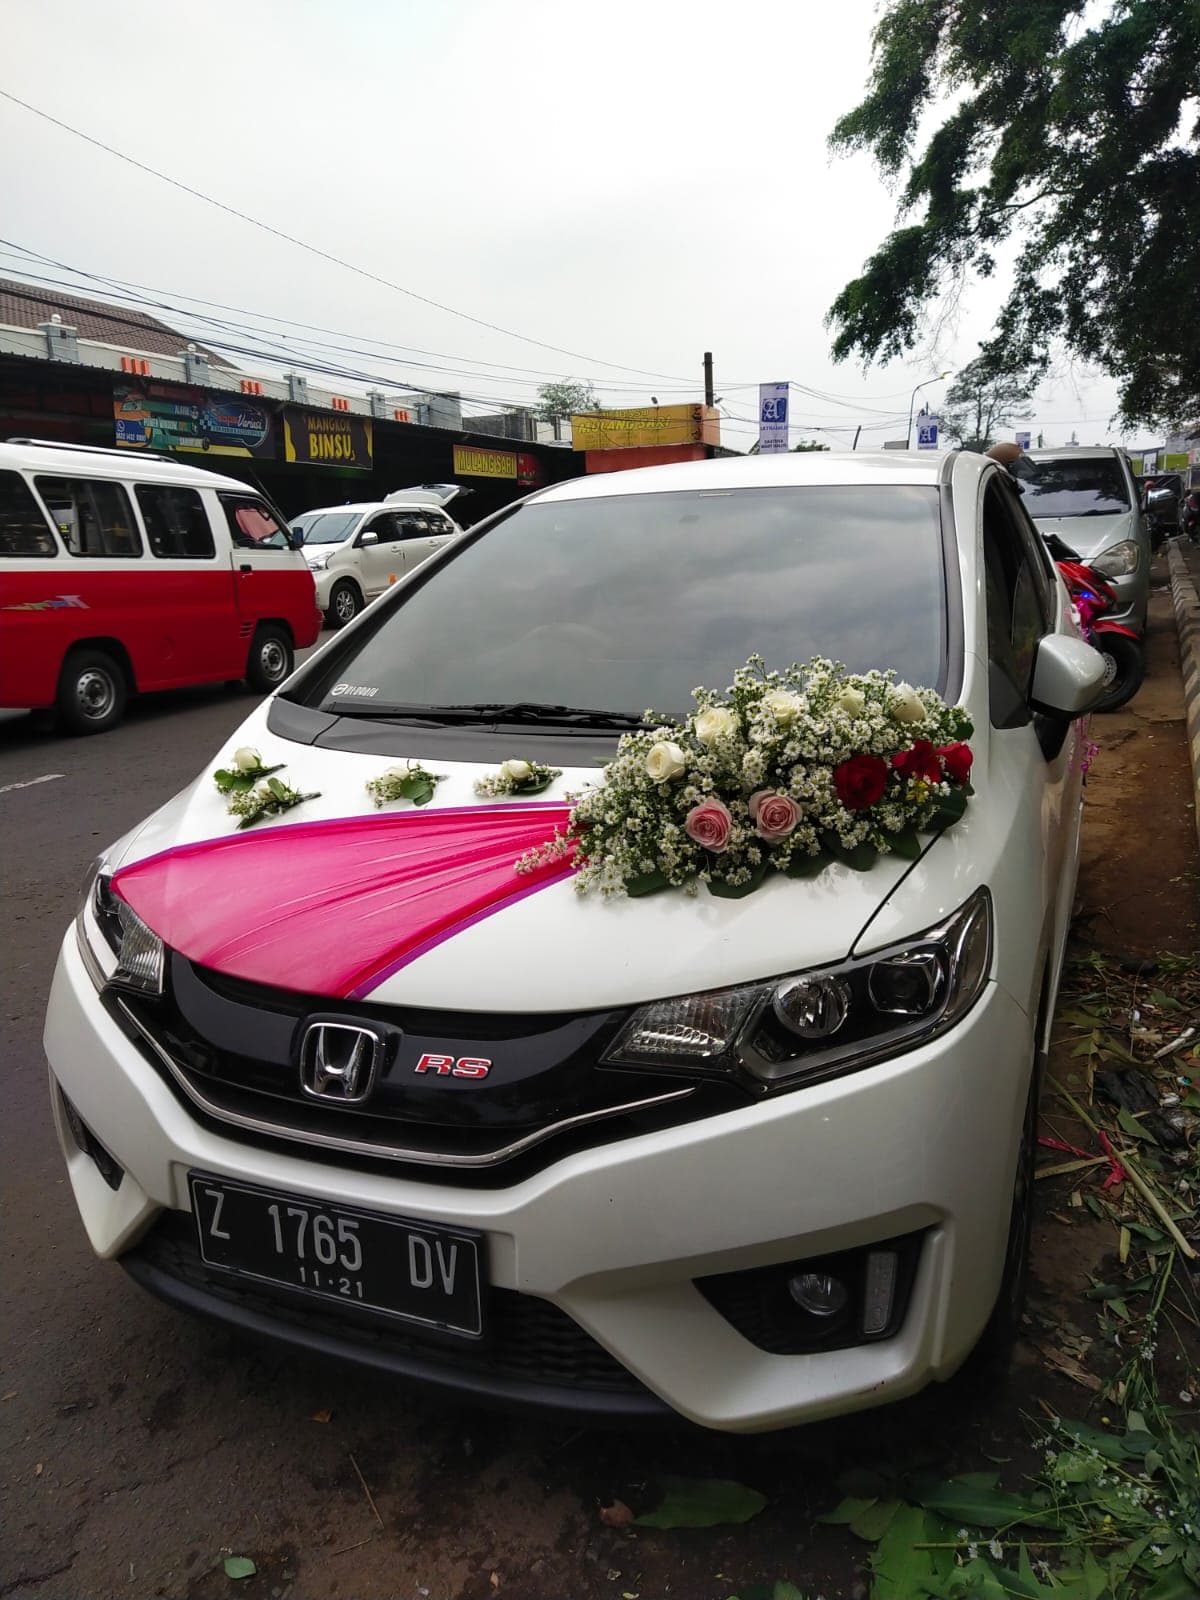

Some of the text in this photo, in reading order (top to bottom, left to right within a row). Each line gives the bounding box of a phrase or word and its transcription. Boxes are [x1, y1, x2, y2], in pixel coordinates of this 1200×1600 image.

[457, 449, 495, 474] MULANG
[496, 454, 515, 475] SARI
[414, 1053, 492, 1079] RS
[205, 1189, 458, 1296] Z 1765 DV
